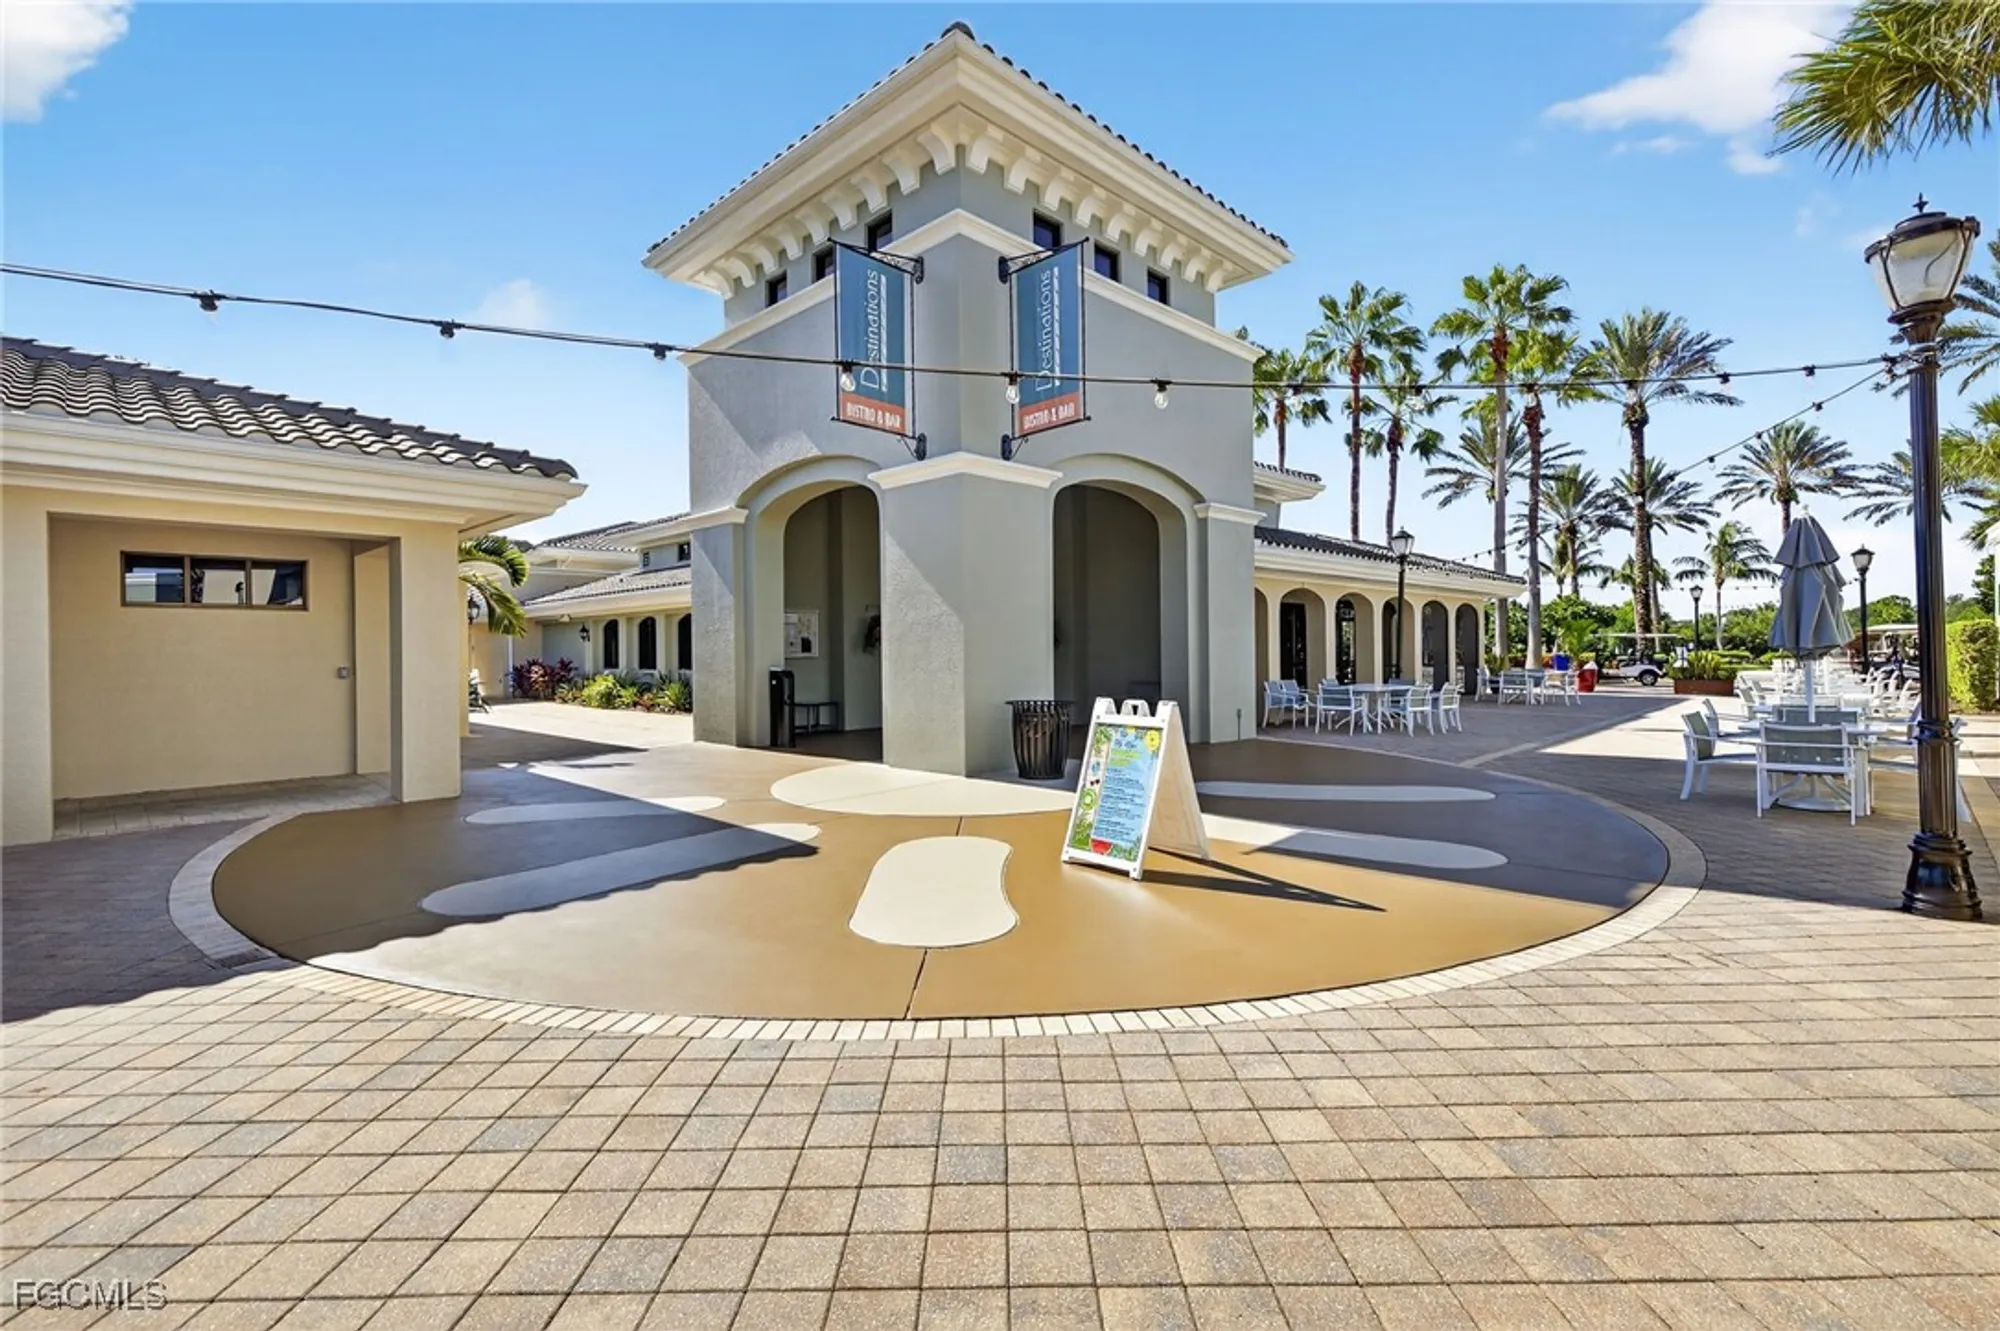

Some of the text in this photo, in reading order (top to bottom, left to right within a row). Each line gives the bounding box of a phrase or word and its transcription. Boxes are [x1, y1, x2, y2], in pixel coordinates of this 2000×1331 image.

[1035, 269, 1052, 392] Destinations
[846, 402, 901, 429] BISTRO & BAR
[1023, 409, 1050, 430] BISTRO
[1058, 402, 1075, 420] BAR
